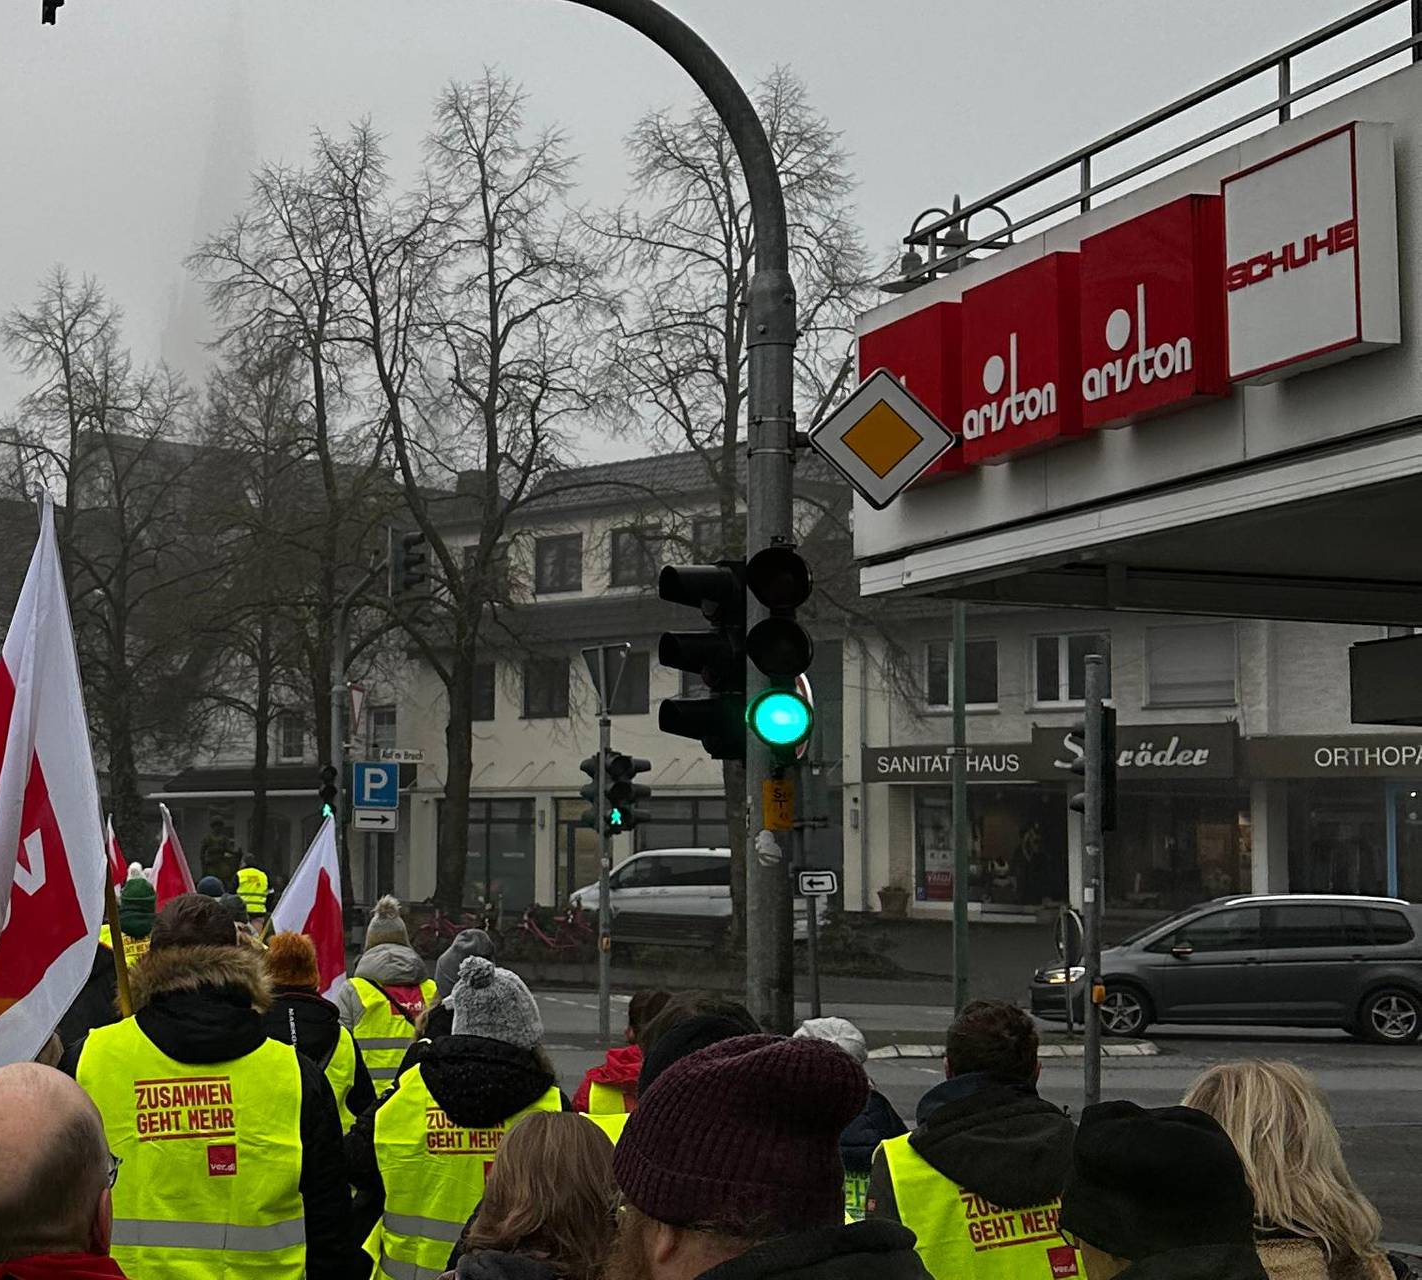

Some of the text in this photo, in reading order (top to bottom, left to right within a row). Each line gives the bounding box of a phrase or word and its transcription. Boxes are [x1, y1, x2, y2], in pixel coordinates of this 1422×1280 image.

[1226, 219, 1356, 292] SCHUHE
[1082, 283, 1192, 401] ariston
[962, 332, 1057, 440] ariston
[877, 753, 1020, 773] SANITÄTHAUS
[1053, 733, 1209, 768] Sröder
[364, 768, 388, 801] P
[135, 1083, 233, 1110] ZUSAMMEN
[136, 1107, 235, 1134] GEHT MEHR
[426, 1131, 464, 1148] GEHT
[967, 1215, 1017, 1244] GEHT
